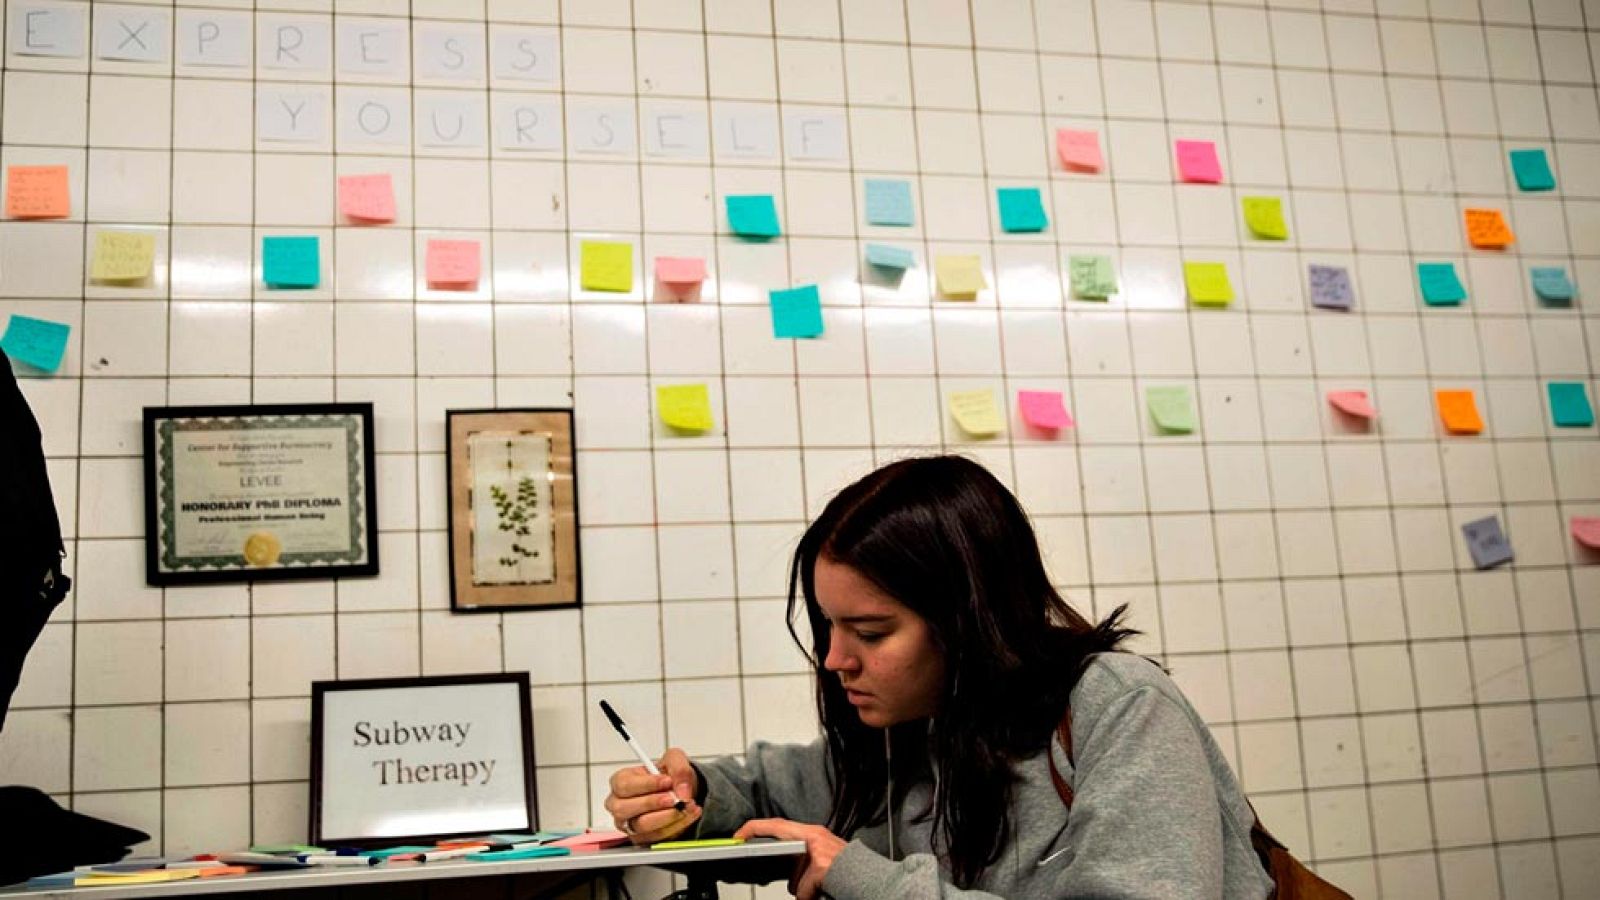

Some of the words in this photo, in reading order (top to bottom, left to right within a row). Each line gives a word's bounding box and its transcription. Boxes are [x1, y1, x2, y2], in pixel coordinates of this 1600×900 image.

[26, 10, 537, 72] EXPRESS
[279, 97, 823, 153] YOURSELF
[239, 475, 283, 488] LEVEE
[181, 500, 252, 512] HONORARY
[284, 497, 341, 509] DIPLOMA
[353, 720, 471, 748] Subway
[372, 758, 496, 787] Therapy
